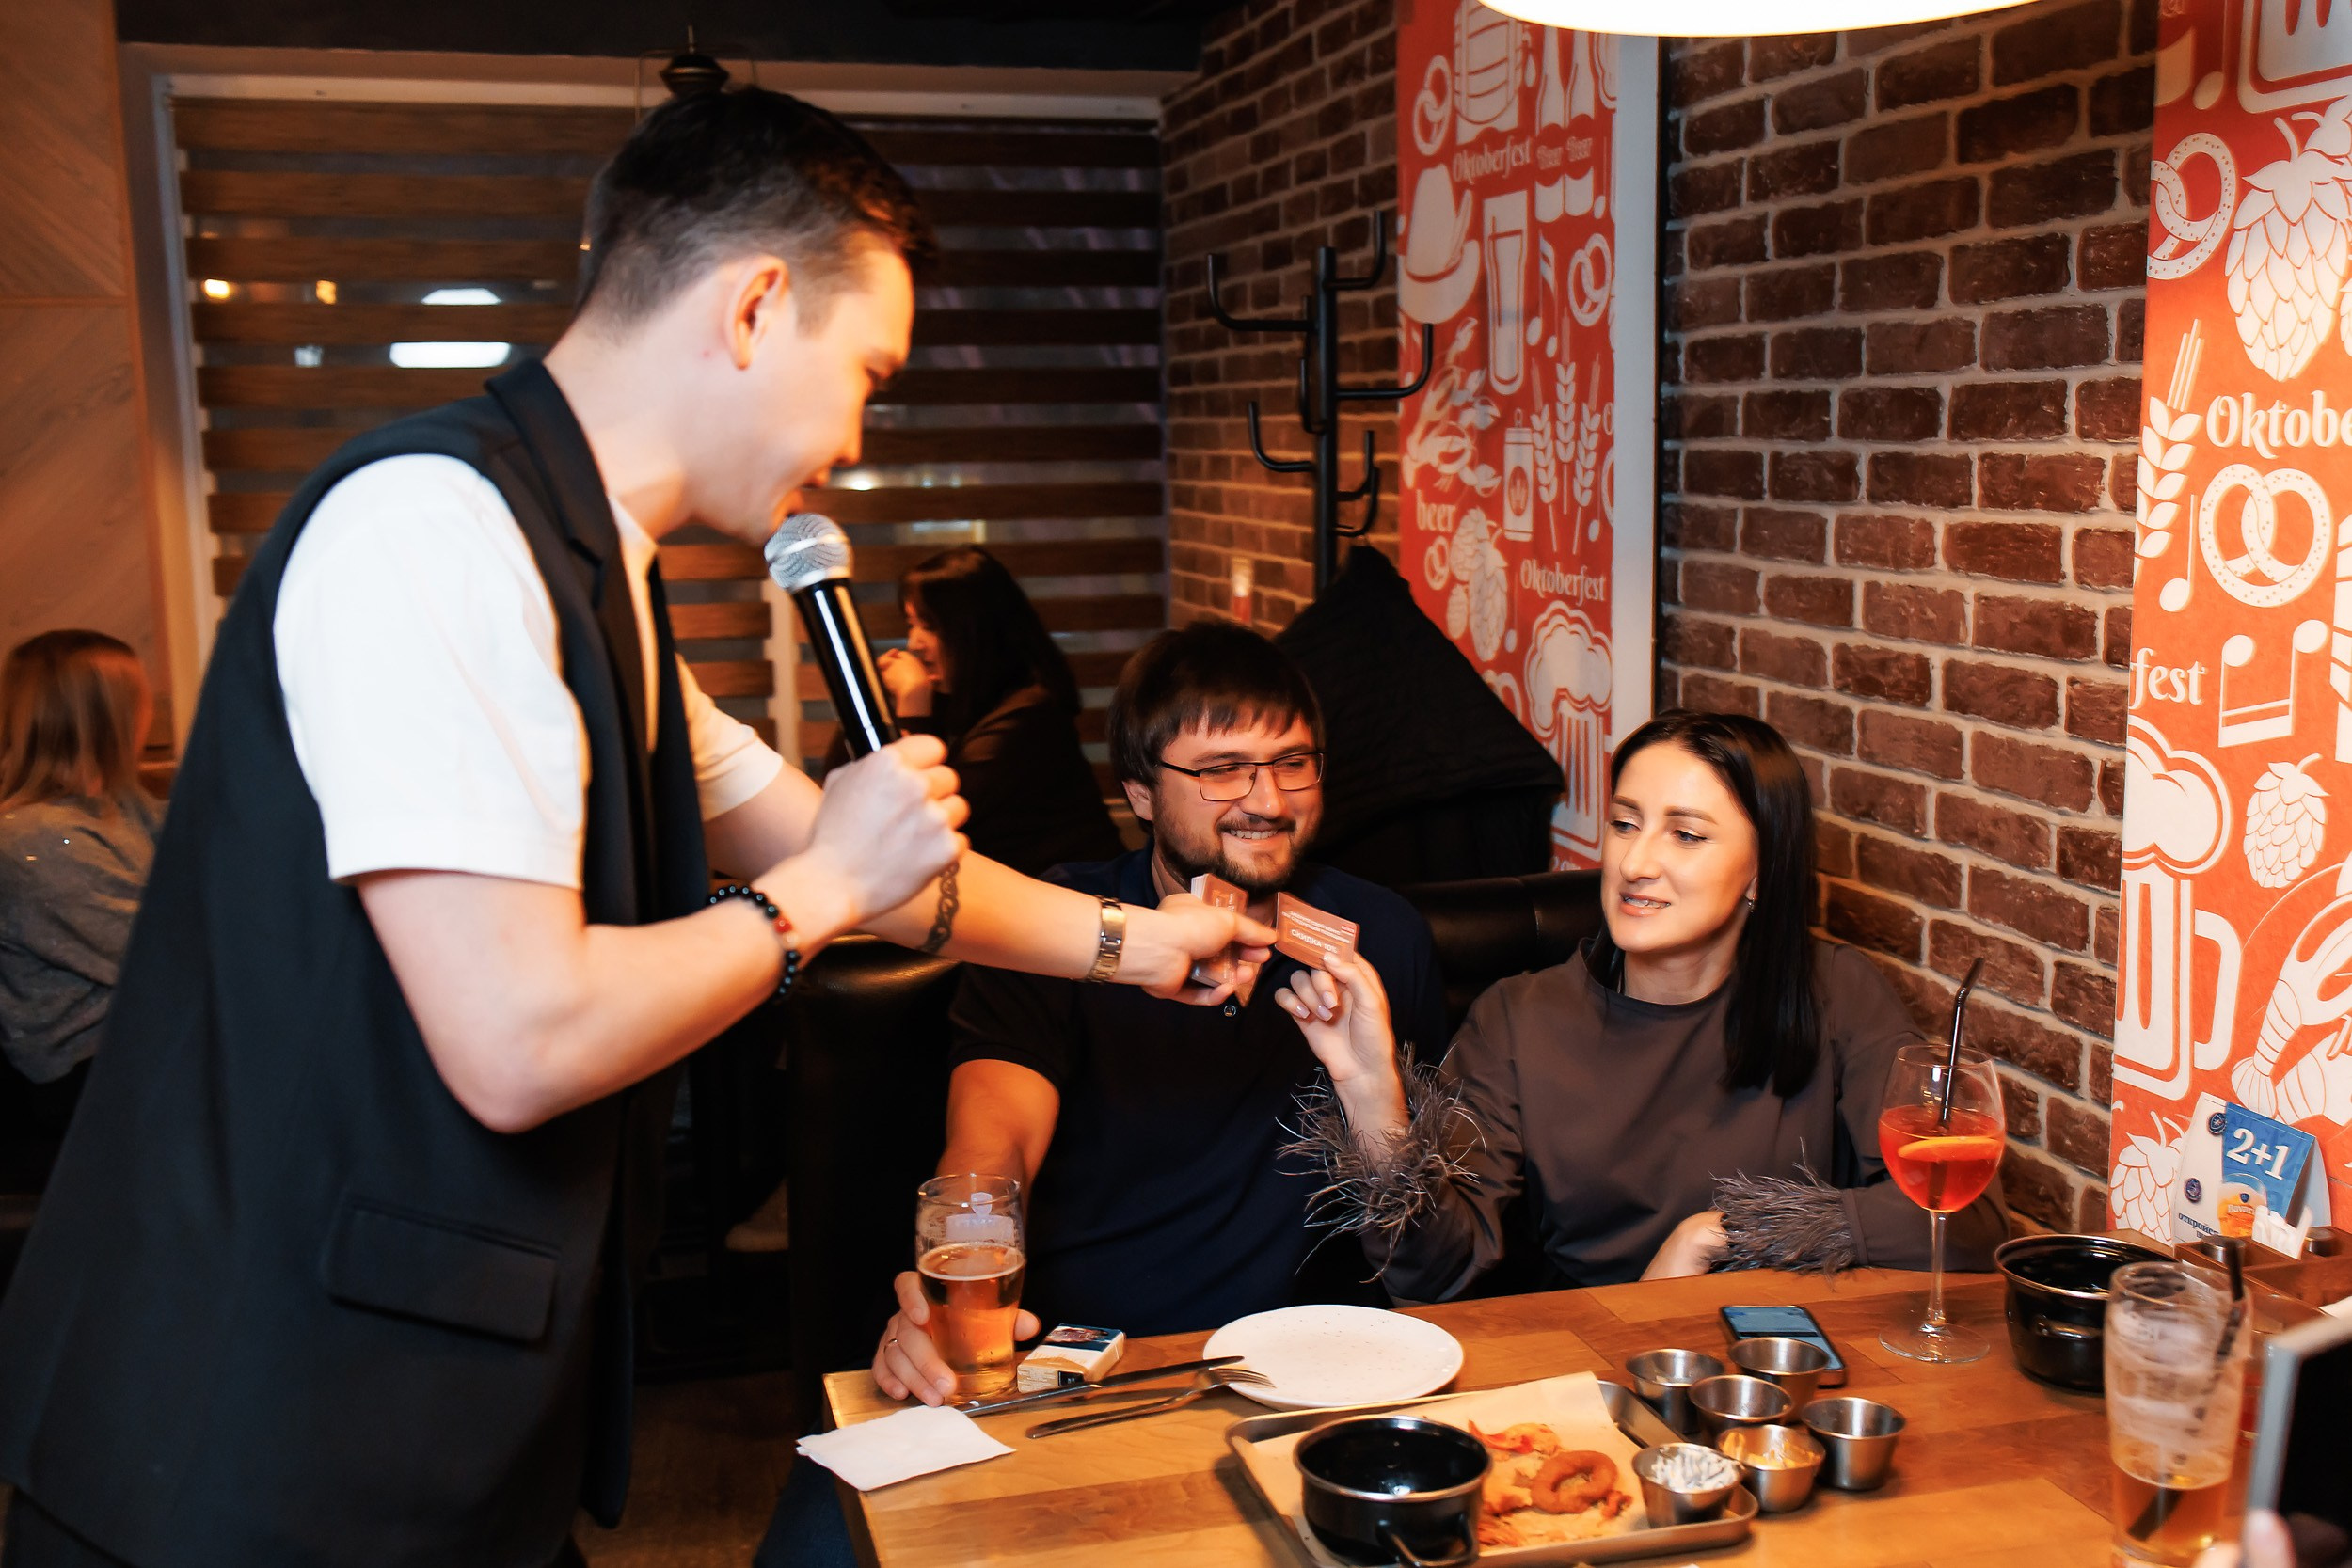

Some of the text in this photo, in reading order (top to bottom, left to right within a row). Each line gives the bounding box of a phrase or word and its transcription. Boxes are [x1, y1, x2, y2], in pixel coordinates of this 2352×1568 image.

[1453, 135, 1533, 185] Oktoberfest
[1416, 489, 1456, 532] beer
[1520, 559, 1606, 606] Oktoberfest
[1291, 929, 1322, 948] СКИДКА
[2226, 1128, 2290, 1180] 2+1
